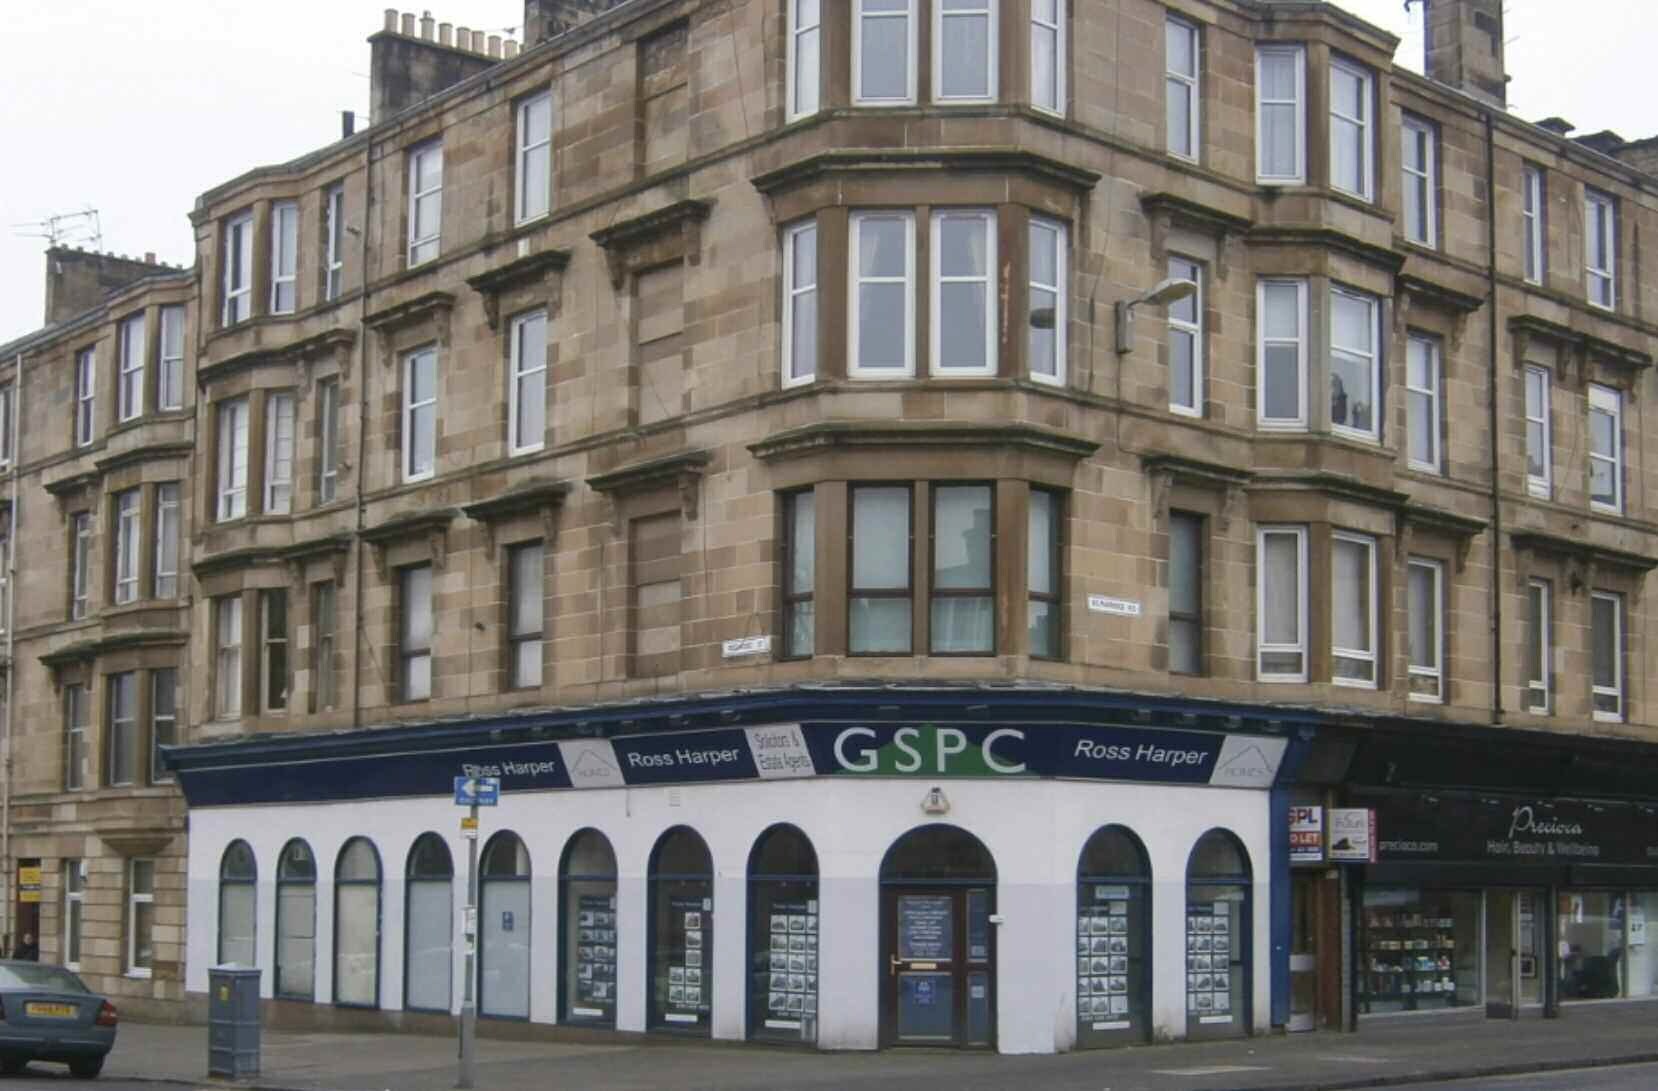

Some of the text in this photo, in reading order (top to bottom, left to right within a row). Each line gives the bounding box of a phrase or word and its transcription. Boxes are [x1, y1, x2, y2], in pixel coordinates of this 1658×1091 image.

[627, 748, 739, 767] Ross Harper
[833, 727, 1027, 774] GSPC
[1073, 739, 1209, 767] Ross Harper
[502, 761, 555, 777] Harper
